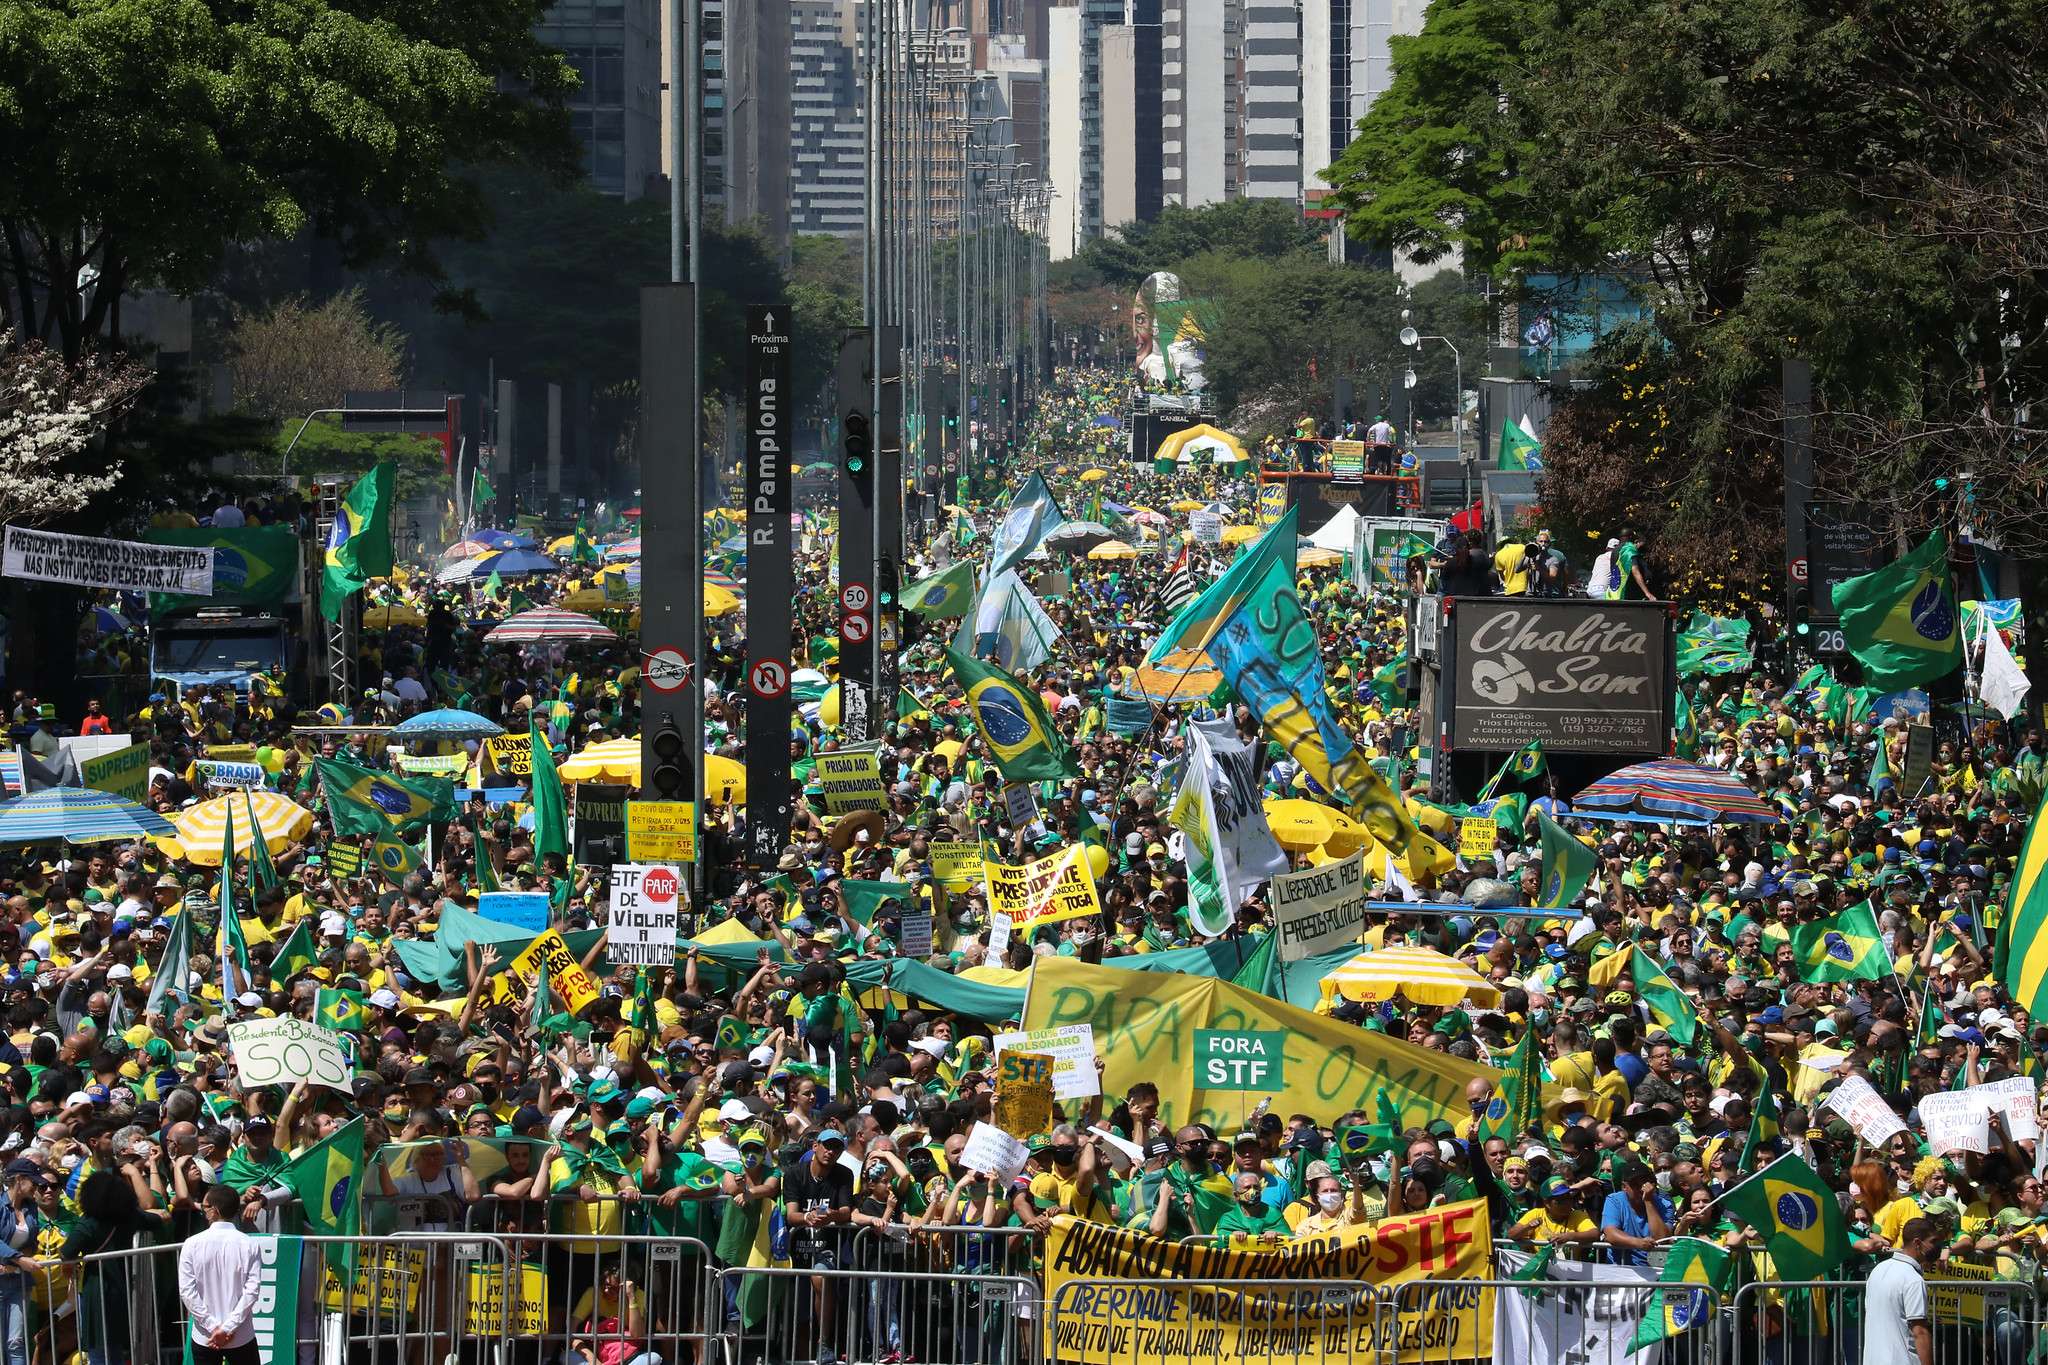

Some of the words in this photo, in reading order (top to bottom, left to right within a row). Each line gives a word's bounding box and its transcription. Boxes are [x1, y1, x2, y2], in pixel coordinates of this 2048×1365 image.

[751, 334, 788, 344] Próxima
[762, 345, 779, 354] rua
[755, 378, 780, 513] Pamplona
[753, 522, 774, 546] R.
[10, 532, 66, 560] PRESIDENTE,
[66, 538, 119, 564] QUEREMOS
[123, 548, 130, 564] O
[132, 549, 206, 570] SANEAMENTO
[24, 556, 42, 575] NAS
[112, 566, 164, 591] FEDERAIS,
[846, 590, 865, 602] 50
[1470, 611, 1647, 654] Chalita
[1818, 630, 1845, 650] 26
[1538, 655, 1648, 694] Som
[1891, 698, 1926, 708] ORBIFIX
[1491, 712, 1534, 721] Locação:
[1504, 718, 1547, 727] Elétricos
[1559, 716, 1581, 726] (19)
[1563, 725, 1584, 734] (19)
[1469, 736, 1650, 747] www.trioeltricochalita.com.br
[88, 748, 148, 784] SUPREMO
[217, 764, 260, 780] BRASIL
[825, 756, 852, 773] PRISÃO
[854, 758, 870, 772] AOS
[823, 778, 882, 794] GOVERNADORES
[576, 801, 624, 822] SUPREM
[640, 805, 656, 813] POVO
[834, 801, 840, 813] E
[1000, 866, 1030, 880] VOTEI
[1037, 859, 1054, 873] NO
[610, 871, 641, 887] STF
[645, 878, 676, 894] PARE
[992, 864, 1081, 900] PRESIDENTE
[1278, 869, 1337, 905] LIBERDADE
[1340, 860, 1359, 888] AOS
[620, 892, 638, 907] DE
[1001, 900, 1016, 909] NÃO
[1019, 898, 1031, 907] EM
[1076, 883, 1088, 892] DE
[998, 900, 1058, 924] TADORES
[1063, 893, 1094, 912] TOGA
[639, 929, 648, 941] A
[1282, 912, 1327, 945] PRESOS
[230, 1024, 289, 1042] Presidente
[284, 1020, 340, 1049] Bolsonaro
[1008, 1036, 1080, 1051] BOLSONARO
[1027, 1030, 1058, 1040] 100%
[1049, 986, 1182, 1063] PARA
[1316, 1045, 1356, 1100] O
[1208, 1036, 1266, 1055] FORA
[246, 1043, 345, 1083] SOS
[1003, 1056, 1047, 1083] STF
[1206, 1058, 1269, 1086] STF
[2003, 1079, 2032, 1094] GERAL
[1861, 1115, 1874, 1126] DE
[1001, 1154, 1014, 1166] FORO
[1054, 1219, 1167, 1279] ABAIXO
[1170, 1244, 1194, 1280] A
[1200, 1236, 1342, 1279] DITADURA
[1376, 1208, 1474, 1274] STF
[1057, 1286, 1182, 1322] LIBERDADE
[1186, 1292, 1243, 1322] PARA
[1250, 1294, 1279, 1322] OS
[1929, 1296, 1959, 1308] LITAR
[1057, 1320, 1109, 1352] DIREITO
[1110, 1326, 1131, 1355] DE
[1135, 1327, 1230, 1362] TRABALHAR,
[1234, 1326, 1316, 1357] LIBERDADE
[1326, 1324, 1348, 1354] DE
